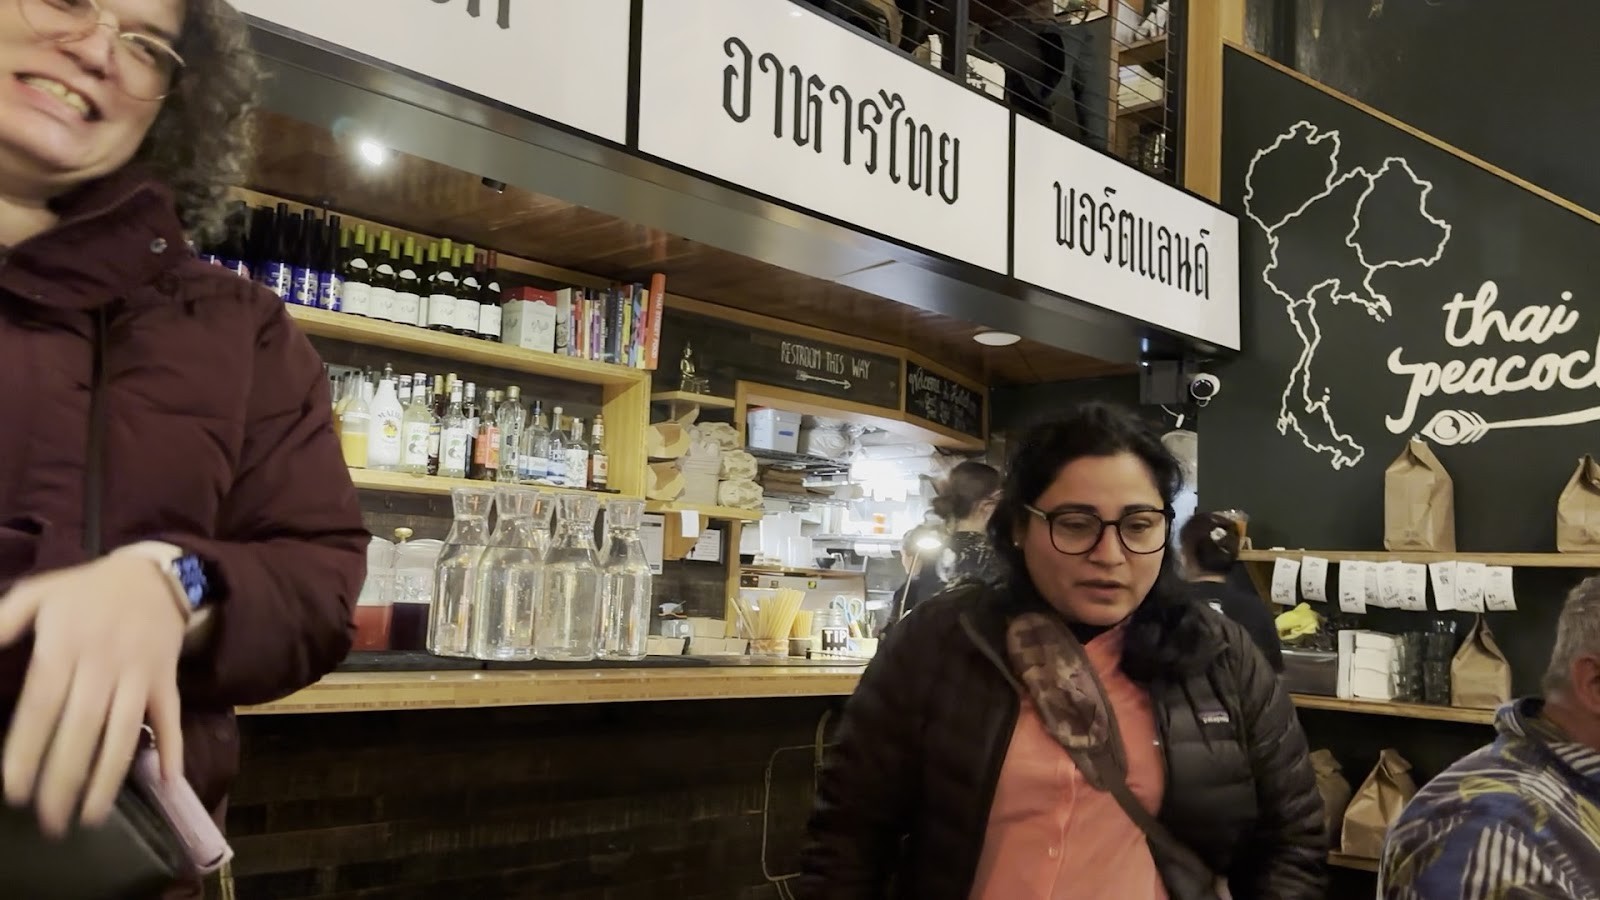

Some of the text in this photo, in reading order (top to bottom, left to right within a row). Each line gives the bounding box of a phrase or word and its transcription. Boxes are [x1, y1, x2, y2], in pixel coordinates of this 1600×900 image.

[723, 37, 960, 205] อาหารไทย
[1053, 181, 1211, 300] พอร์ตแลนด์
[1442, 280, 1580, 347] thai
[780, 341, 872, 380] RESTROOM THIS WAY
[824, 630, 847, 643] TIP
